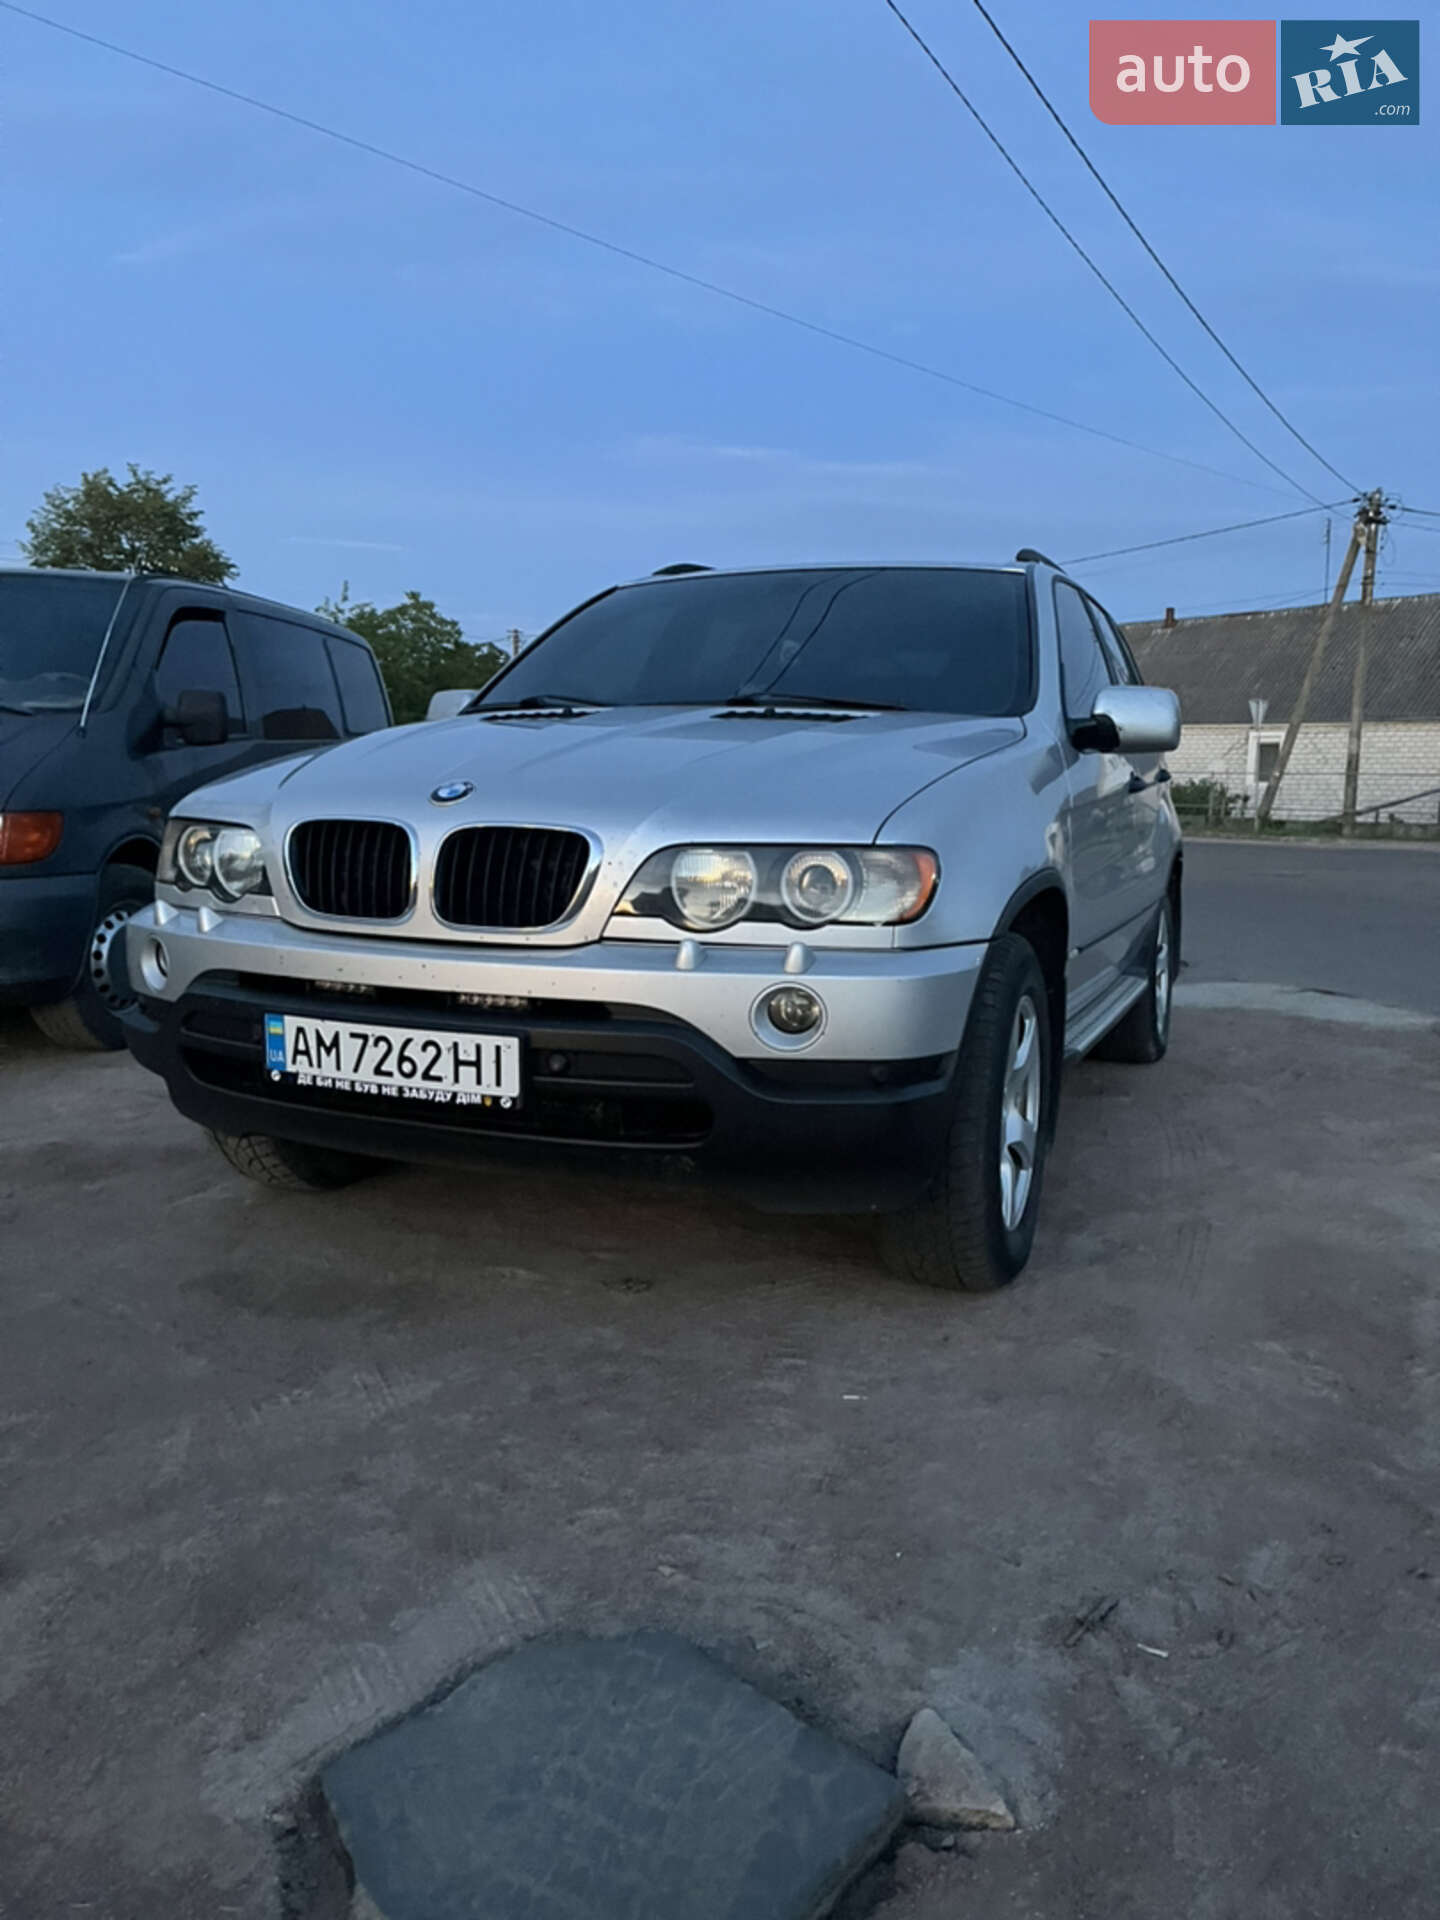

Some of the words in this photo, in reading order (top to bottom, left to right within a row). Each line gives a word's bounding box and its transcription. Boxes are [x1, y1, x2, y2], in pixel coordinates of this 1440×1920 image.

[269, 1048, 285, 1063] UA
[297, 1073, 312, 1086] ДЕ
[316, 1076, 332, 1088] БИ
[335, 1079, 351, 1091] НЕ
[354, 1081, 378, 1095] БУВ
[381, 1085, 398, 1097] НЕ
[402, 1087, 452, 1103] ЗАБУДУ
[455, 1093, 482, 1105] ДІМ
